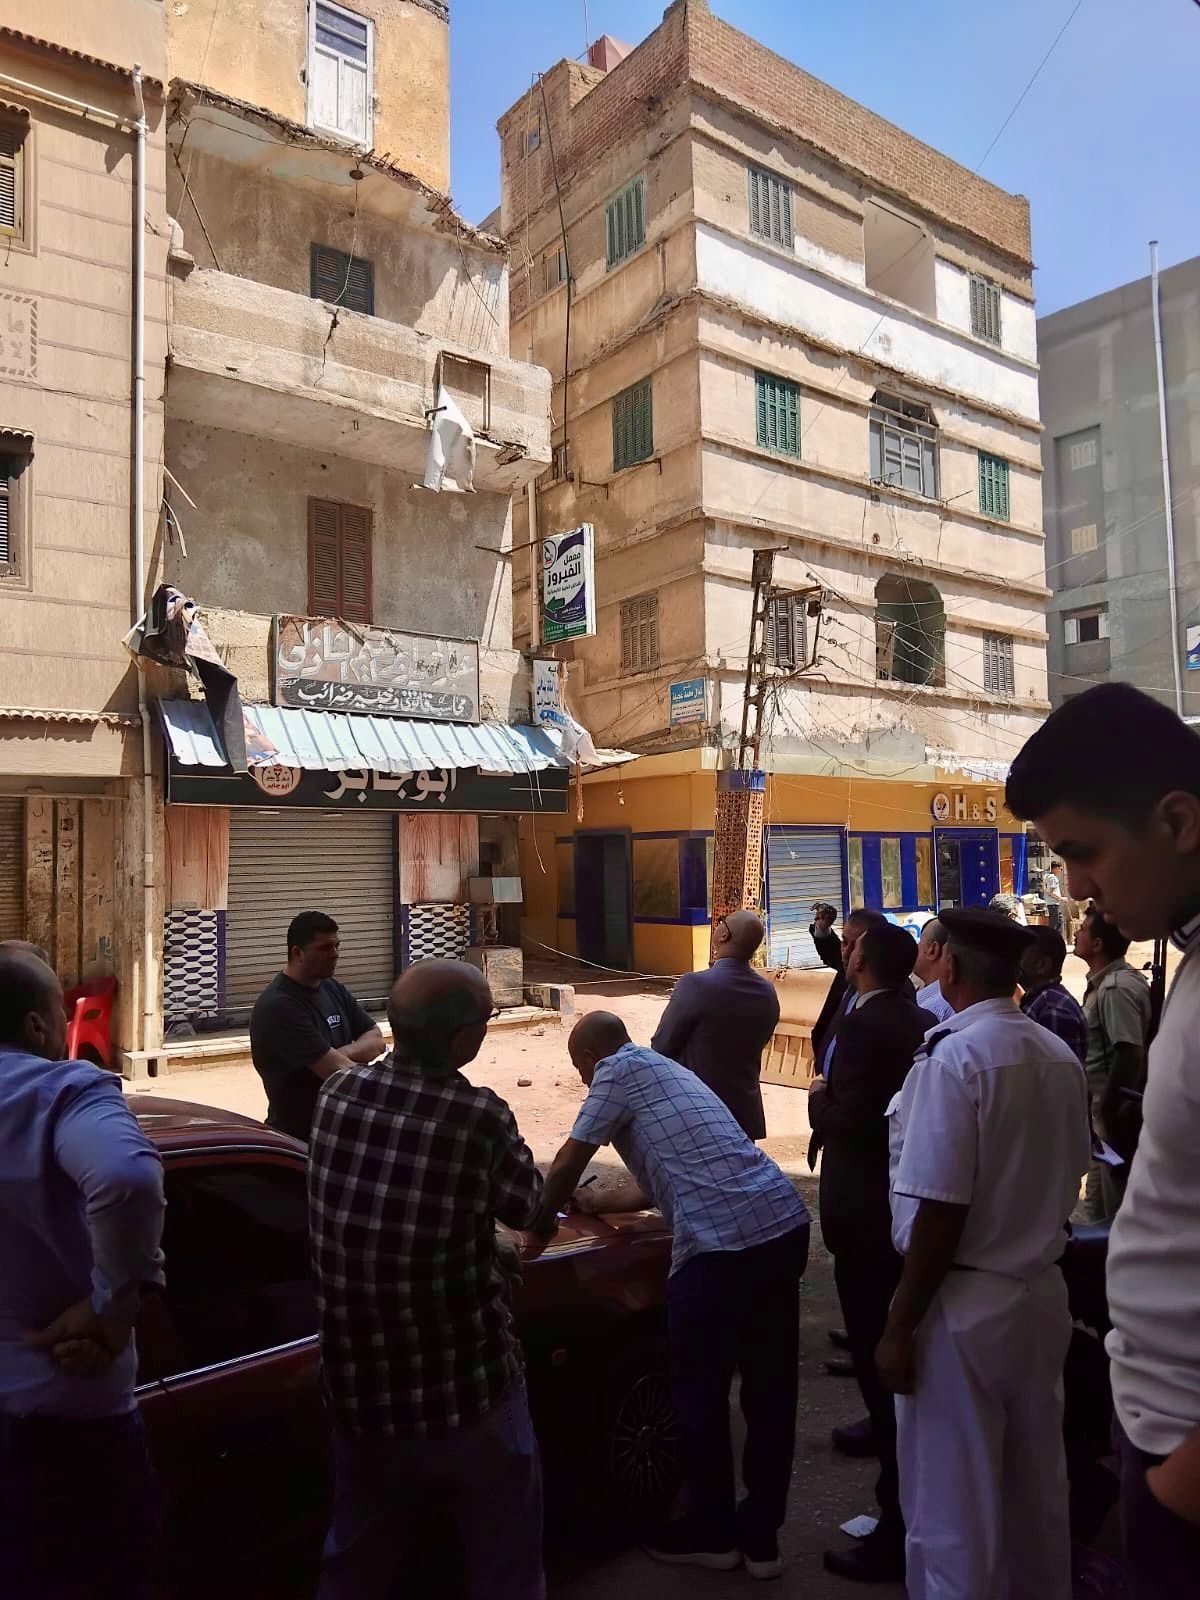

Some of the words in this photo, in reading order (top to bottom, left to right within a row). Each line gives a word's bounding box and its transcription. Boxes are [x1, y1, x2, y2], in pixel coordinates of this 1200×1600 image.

[563, 552, 581, 566] معمل
[547, 561, 581, 587] الفيروز
[297, 682, 354, 707] ضرائب
